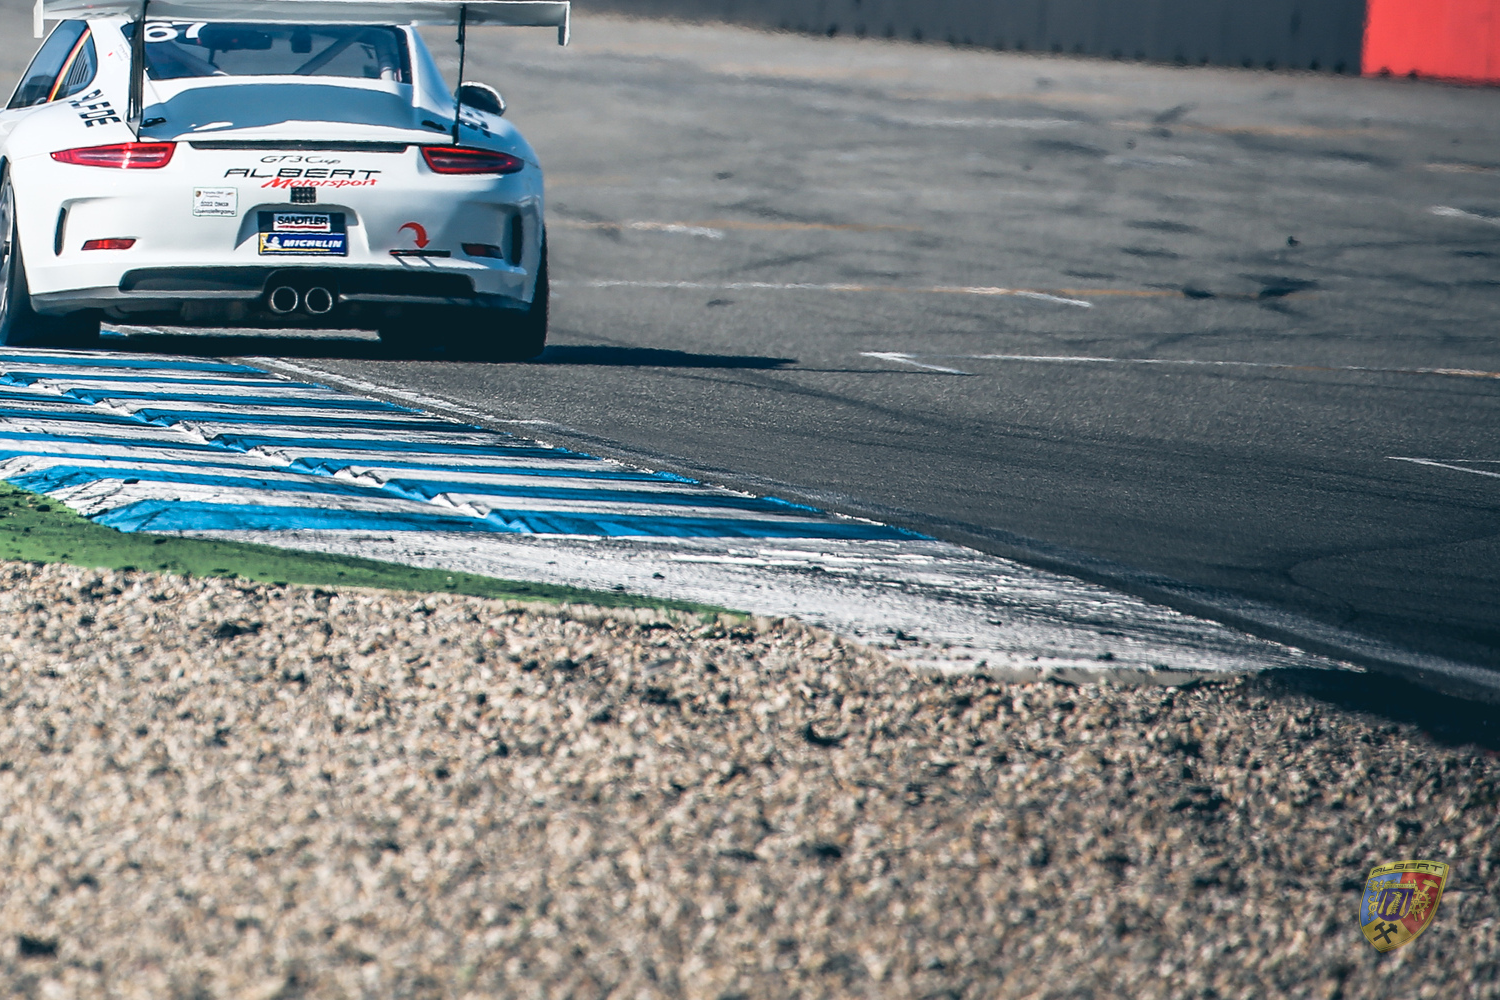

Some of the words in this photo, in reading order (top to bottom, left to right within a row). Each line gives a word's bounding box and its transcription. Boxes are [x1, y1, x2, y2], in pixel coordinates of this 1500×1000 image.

[260, 155, 301, 164] GT3
[302, 155, 342, 165] Cup
[224, 168, 382, 180] ALBERT
[260, 176, 378, 189] Motorsport
[277, 215, 329, 225] SANDTLER
[282, 239, 343, 248] MICHELIN
